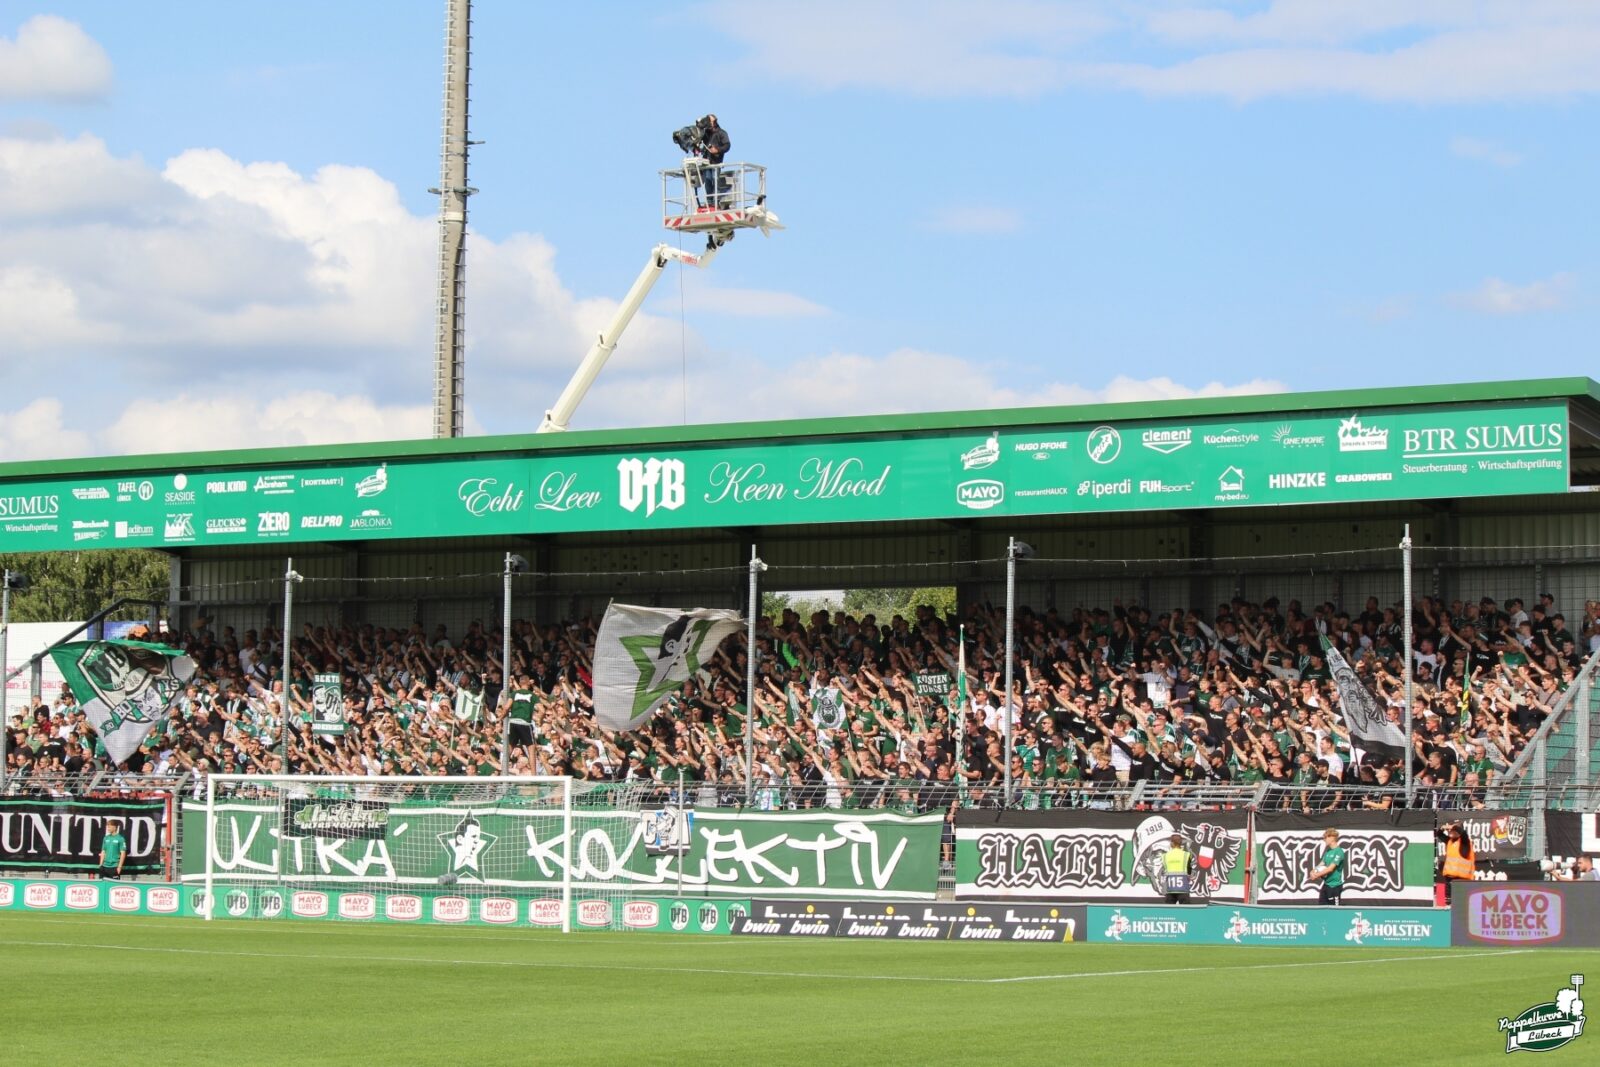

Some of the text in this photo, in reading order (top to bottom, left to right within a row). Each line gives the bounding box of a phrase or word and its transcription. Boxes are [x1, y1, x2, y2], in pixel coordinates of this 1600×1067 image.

[1142, 428, 1191, 441] clement
[1203, 433, 1259, 444] Küchenstyle
[1403, 423, 1562, 452] BTR SUMUS
[1015, 442, 1039, 451] HUGO
[1402, 459, 1562, 474] Steuerberatung Wirtschaftsprüfung
[1269, 472, 1326, 488] HINZKE
[1335, 472, 1392, 482] GRABOWSKI
[117, 482, 137, 492] TAFEL
[458, 478, 525, 517] Echt
[534, 471, 602, 512] Leev
[704, 461, 787, 504] Keen
[794, 457, 891, 500] Mood
[961, 485, 1000, 498] MAYO
[1092, 479, 1131, 498] iperdi
[164, 492, 196, 502] SEASIDE
[0, 495, 58, 515] SUMUS
[5, 523, 58, 533] Wirtschaftsprüfung
[301, 515, 343, 528] DELLPRO
[350, 518, 392, 528] JABLONKA
[439, 900, 464, 908] MAYO
[535, 903, 560, 911] MAYO
[583, 904, 607, 912] MAYO
[629, 905, 653, 913] MAYO
[1482, 894, 1549, 913] MAYO
[742, 919, 781, 934] bwin
[790, 920, 830, 934] bwin
[1133, 921, 1186, 934] HOLSTEN
[1482, 914, 1548, 929] LÜBECK
[848, 921, 889, 936] bwin
[898, 923, 939, 937] bwin
[960, 924, 1002, 938] bwin
[1012, 925, 1055, 940] bwin
[1252, 923, 1307, 935] HOLSTEN
[1374, 924, 1431, 937] HOLSTEN
